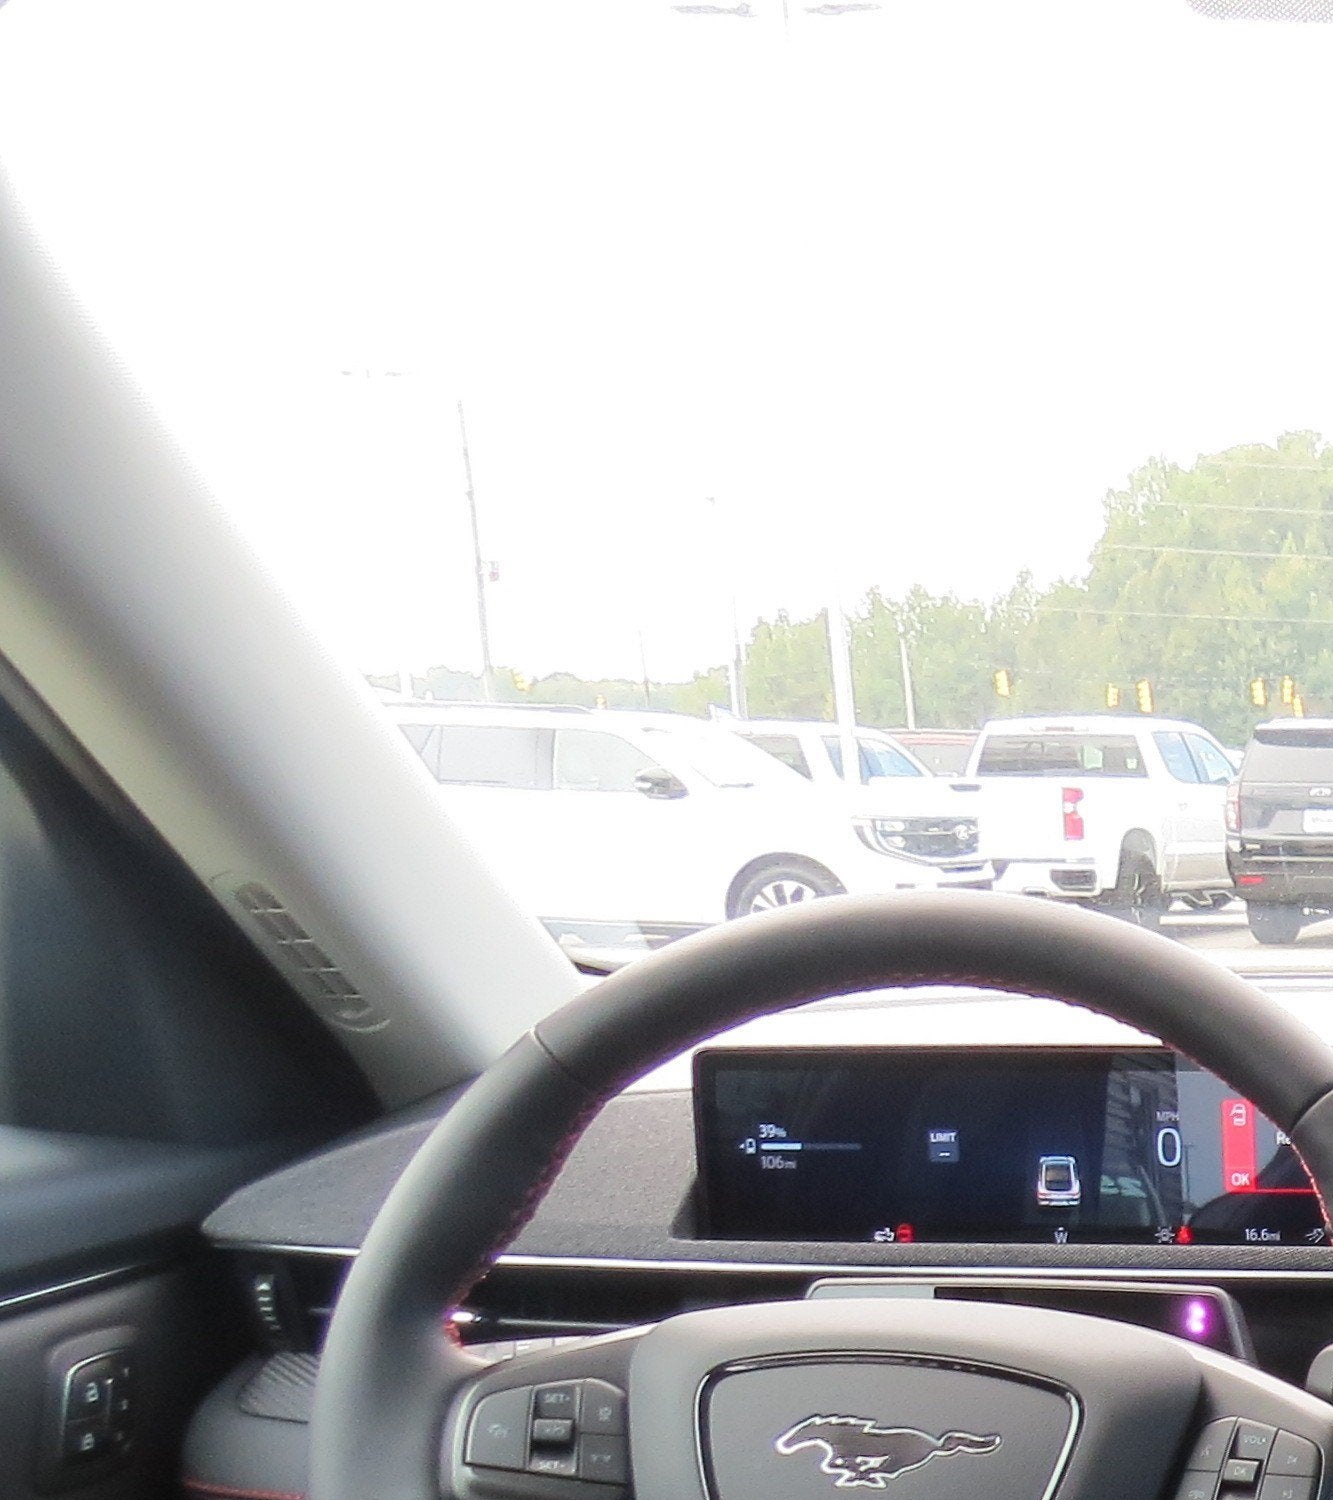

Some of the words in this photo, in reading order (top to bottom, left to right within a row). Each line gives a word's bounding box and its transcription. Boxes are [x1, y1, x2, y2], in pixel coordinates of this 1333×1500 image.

[929, 1131, 957, 1143] LIMIT
[1157, 1127, 1182, 1167] 0
[1231, 1172, 1251, 1187] OK
